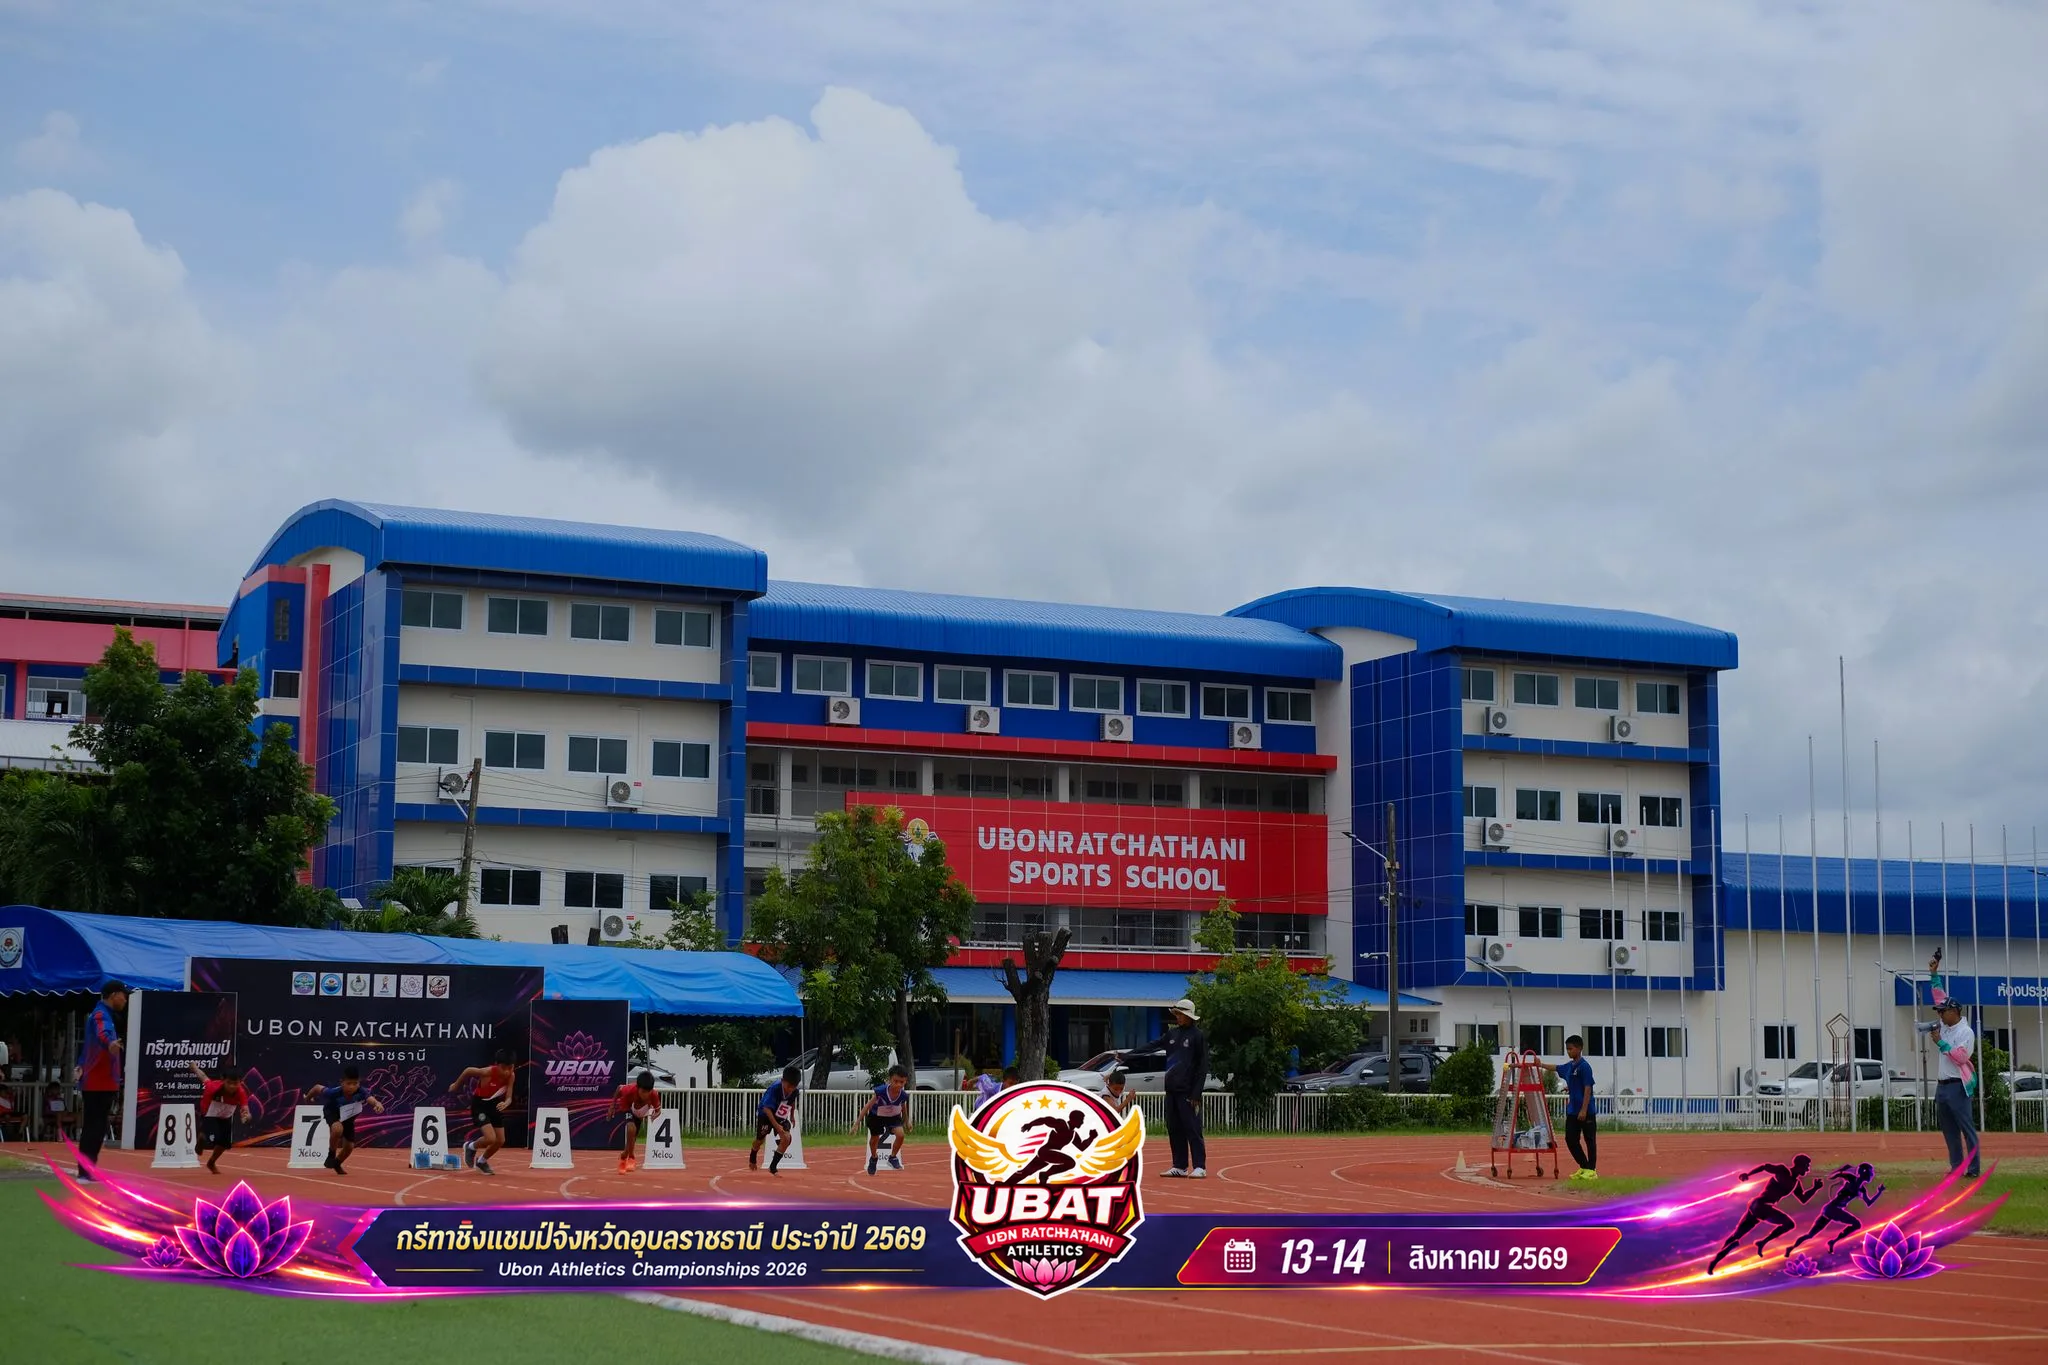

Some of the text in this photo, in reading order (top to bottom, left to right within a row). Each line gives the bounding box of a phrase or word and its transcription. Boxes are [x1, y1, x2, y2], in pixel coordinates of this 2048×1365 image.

[978, 826, 1246, 861] UBONRATCHATHANI
[1009, 861, 1226, 892] SPORTS SCHOOL
[1997, 982, 2048, 1001] ห้องประชุ
[247, 1019, 493, 1040] UBON RATCHATHANI
[545, 1060, 616, 1076] UBON
[546, 1076, 612, 1085] ATHLETICS
[777, 1104, 789, 1117] 5
[164, 1114, 177, 1146] 8
[185, 1112, 192, 1144] 8
[302, 1115, 321, 1146] 7
[421, 1115, 439, 1145] 6
[543, 1117, 562, 1147] 5
[655, 1118, 673, 1148] 4
